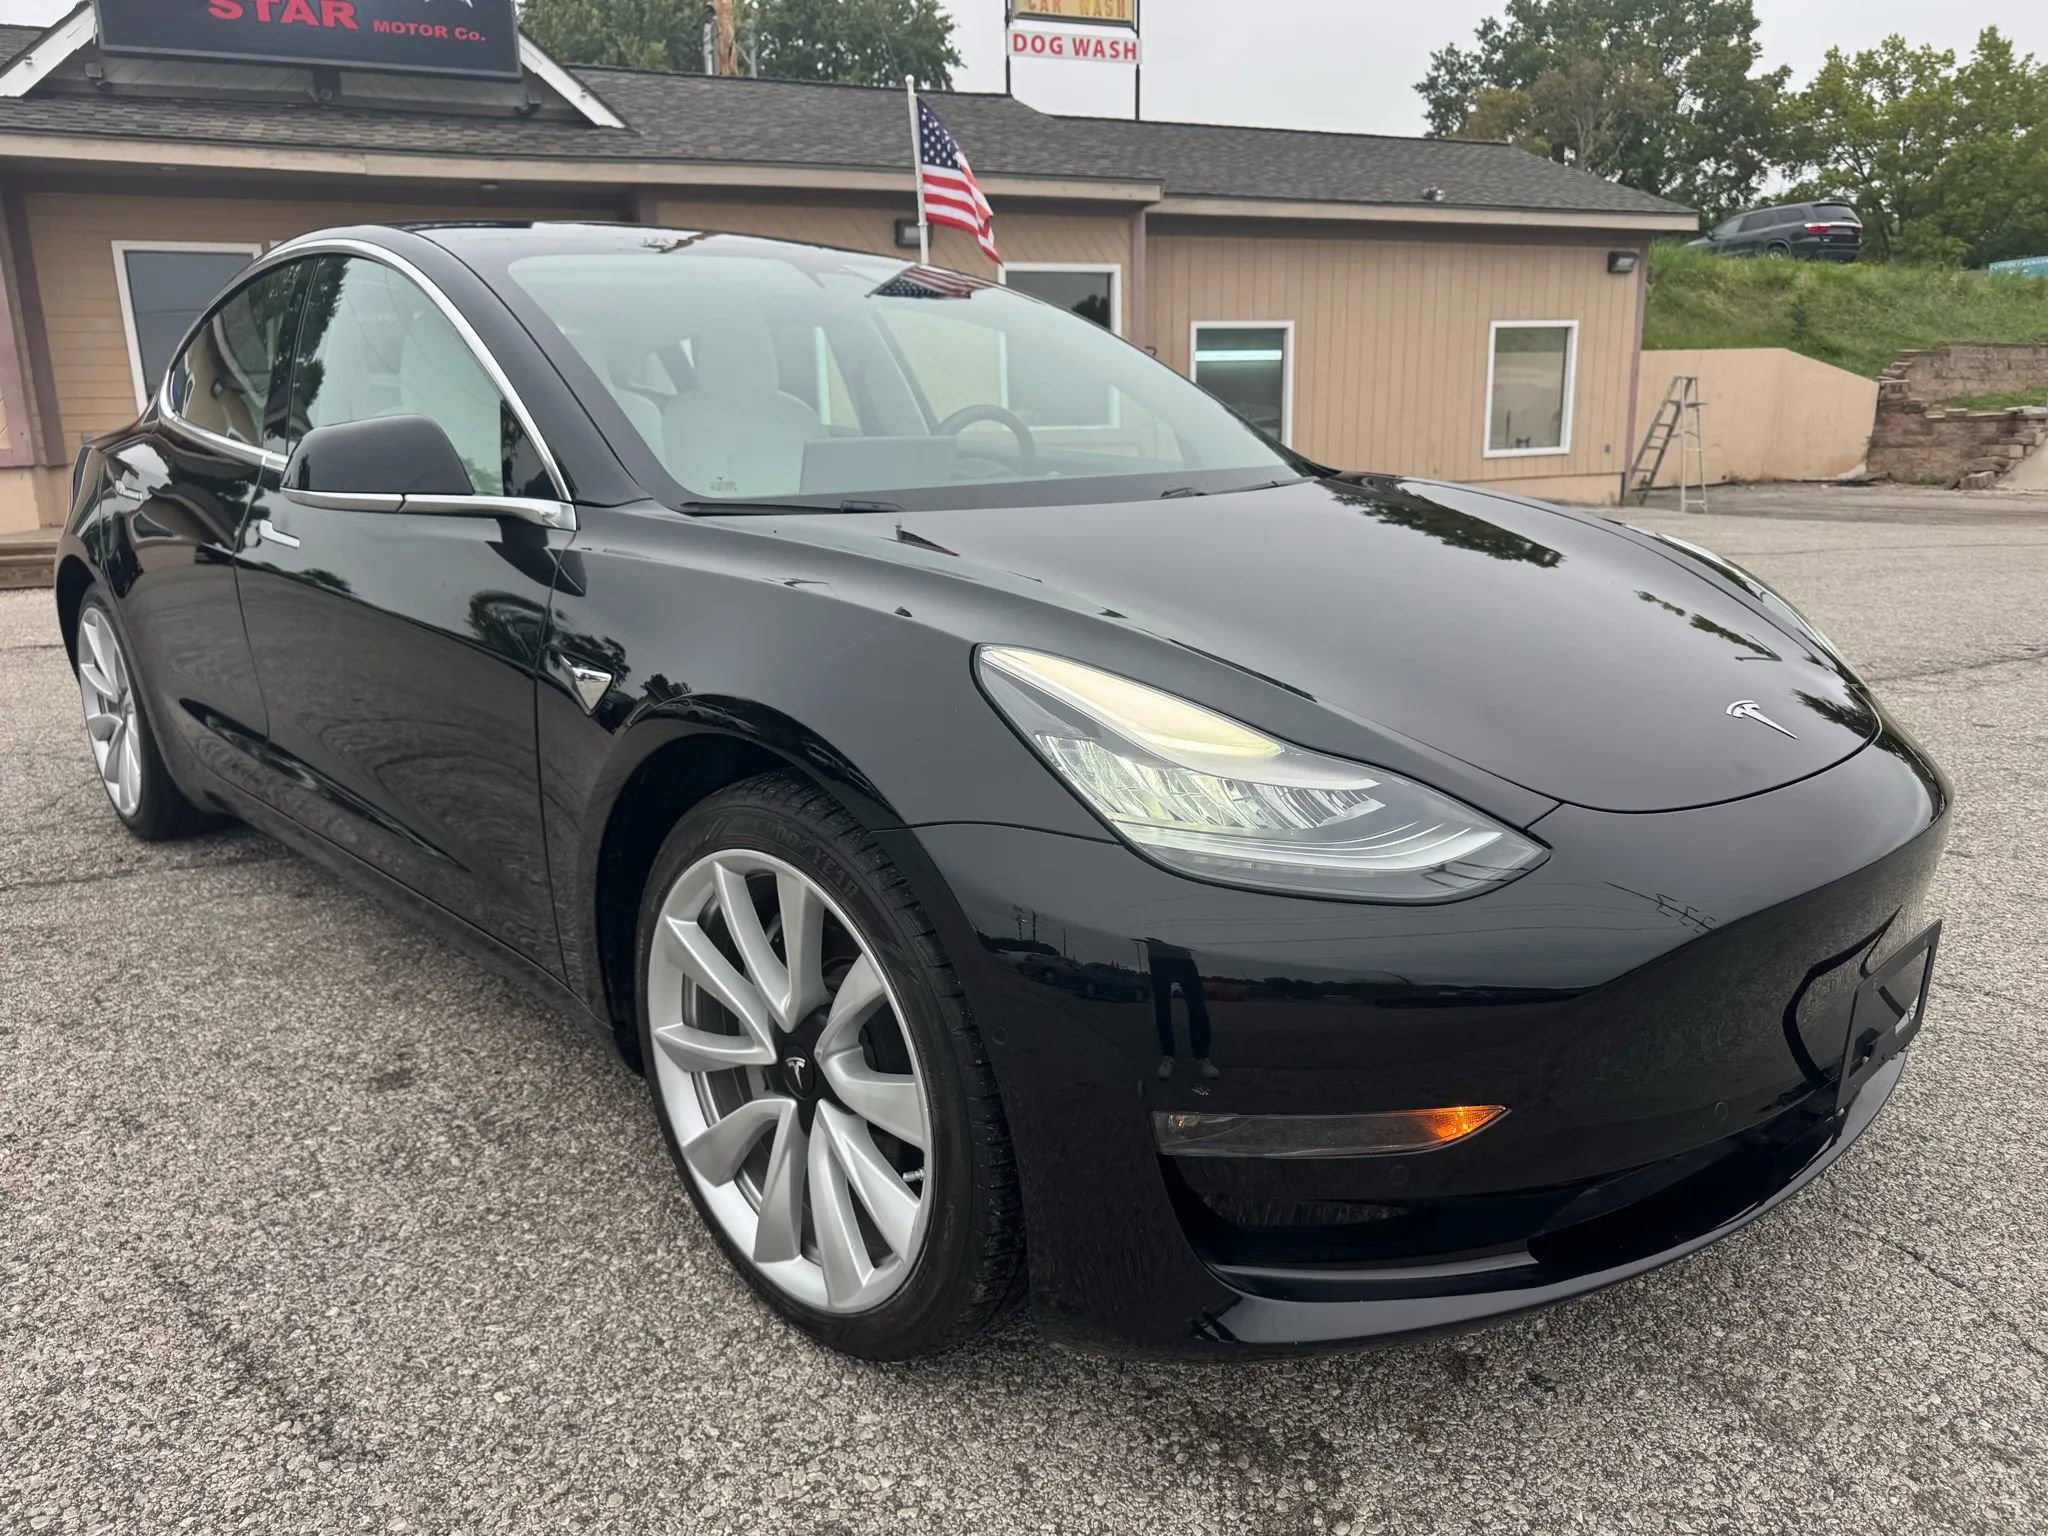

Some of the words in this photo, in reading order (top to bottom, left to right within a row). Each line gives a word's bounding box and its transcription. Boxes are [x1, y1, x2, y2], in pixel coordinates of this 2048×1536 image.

[208, 0, 358, 29] STAR
[372, 20, 448, 38] MOTOR
[454, 26, 486, 41] Co.
[1012, 33, 1064, 55] DOG
[1072, 37, 1137, 61] WASH
